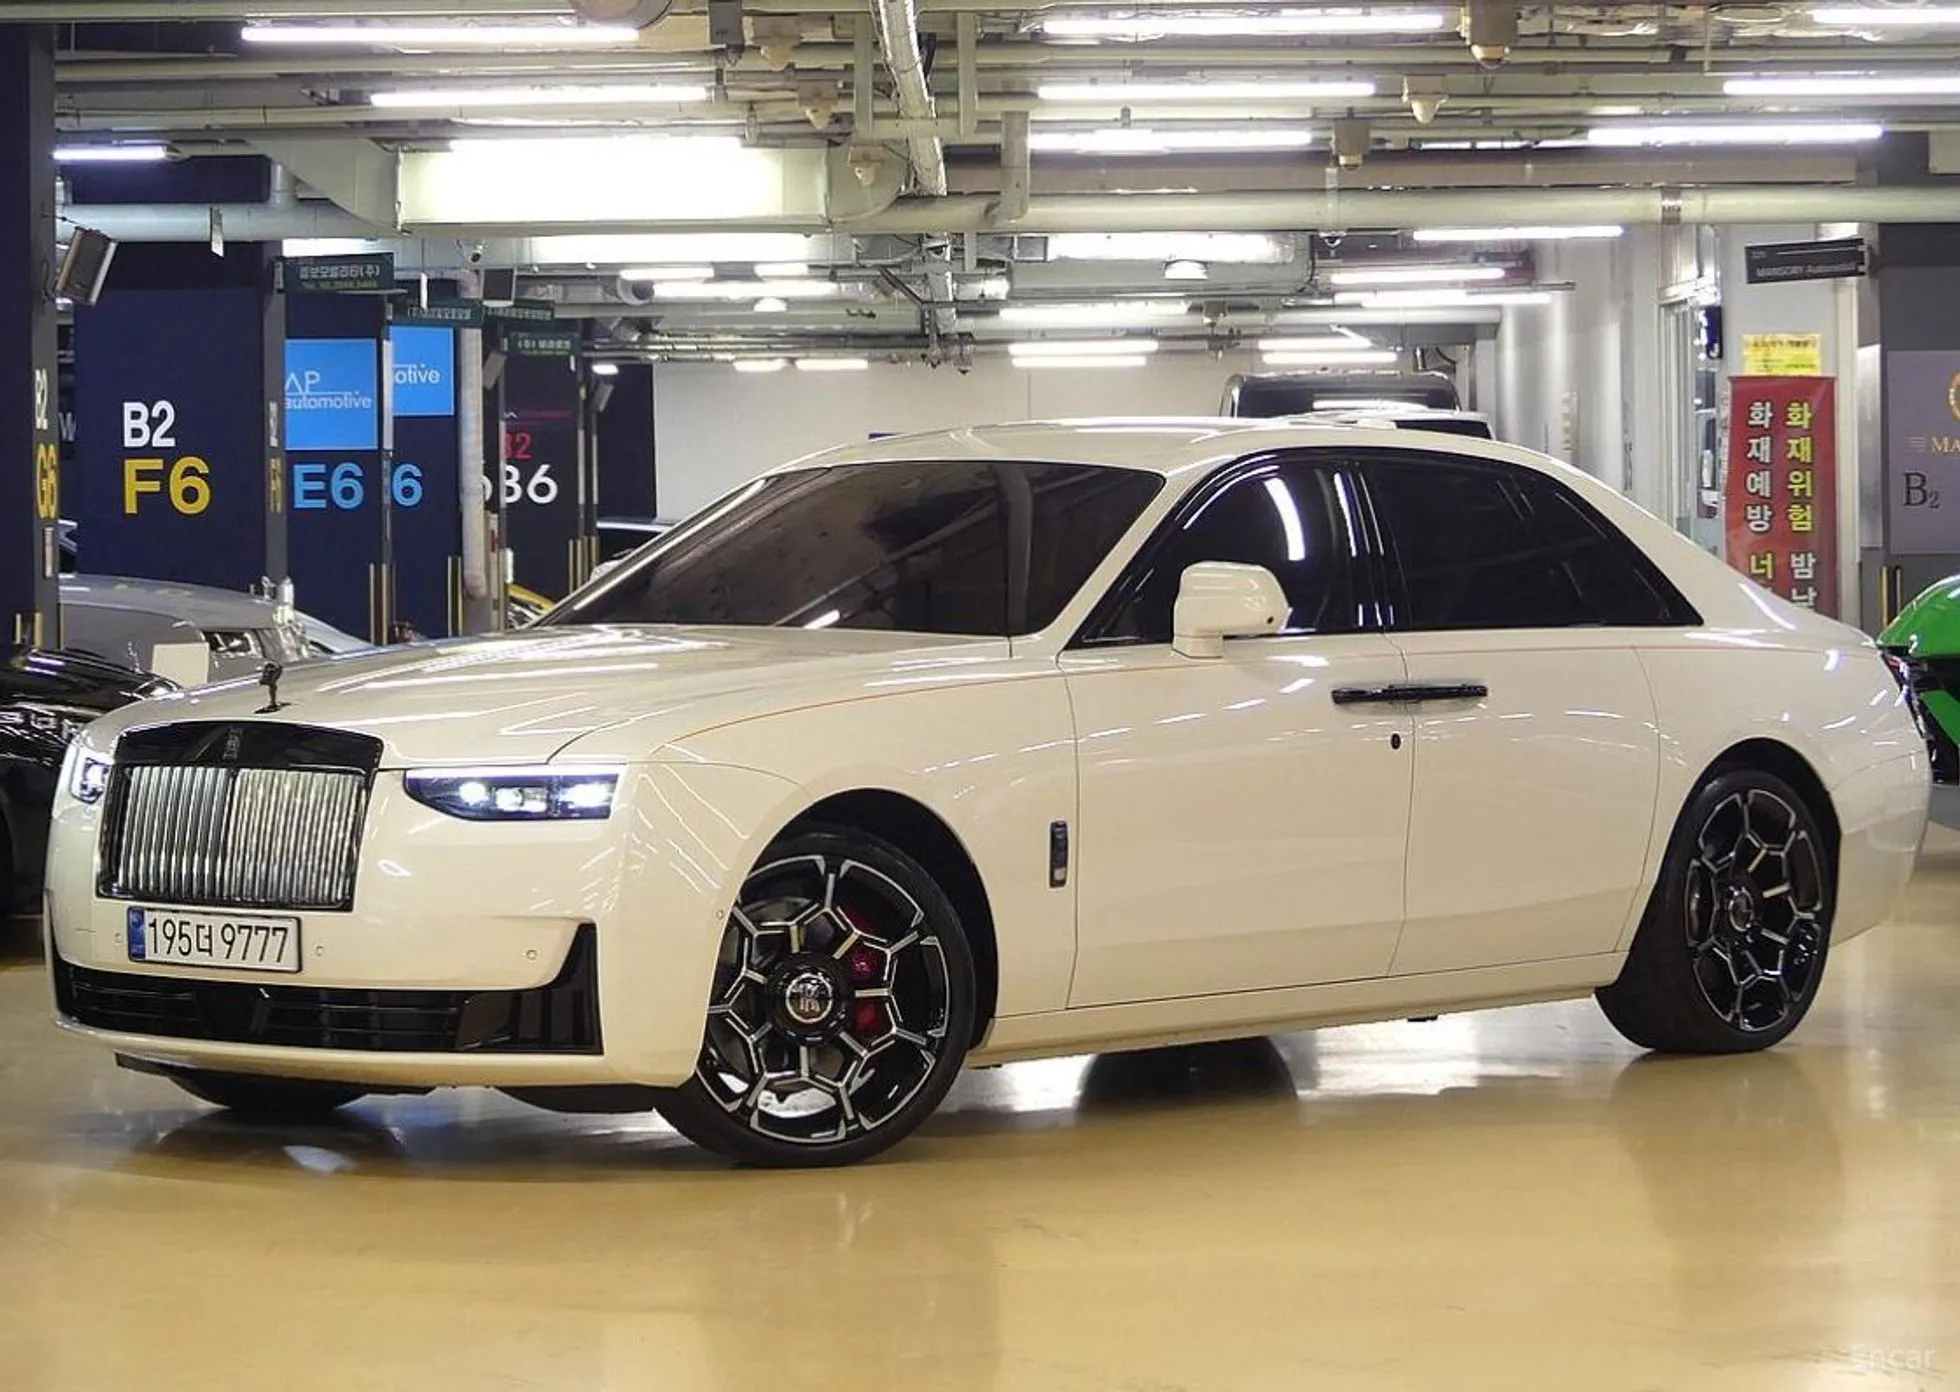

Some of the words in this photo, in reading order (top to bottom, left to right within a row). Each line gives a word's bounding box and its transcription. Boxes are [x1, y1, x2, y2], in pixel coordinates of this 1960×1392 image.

[394, 363, 441, 385] otive
[123, 401, 176, 447] B2
[1931, 436, 1960, 453] MA
[124, 456, 211, 514] F6
[293, 462, 364, 509] E6
[392, 463, 423, 507] 6
[221, 923, 288, 963] 9777
